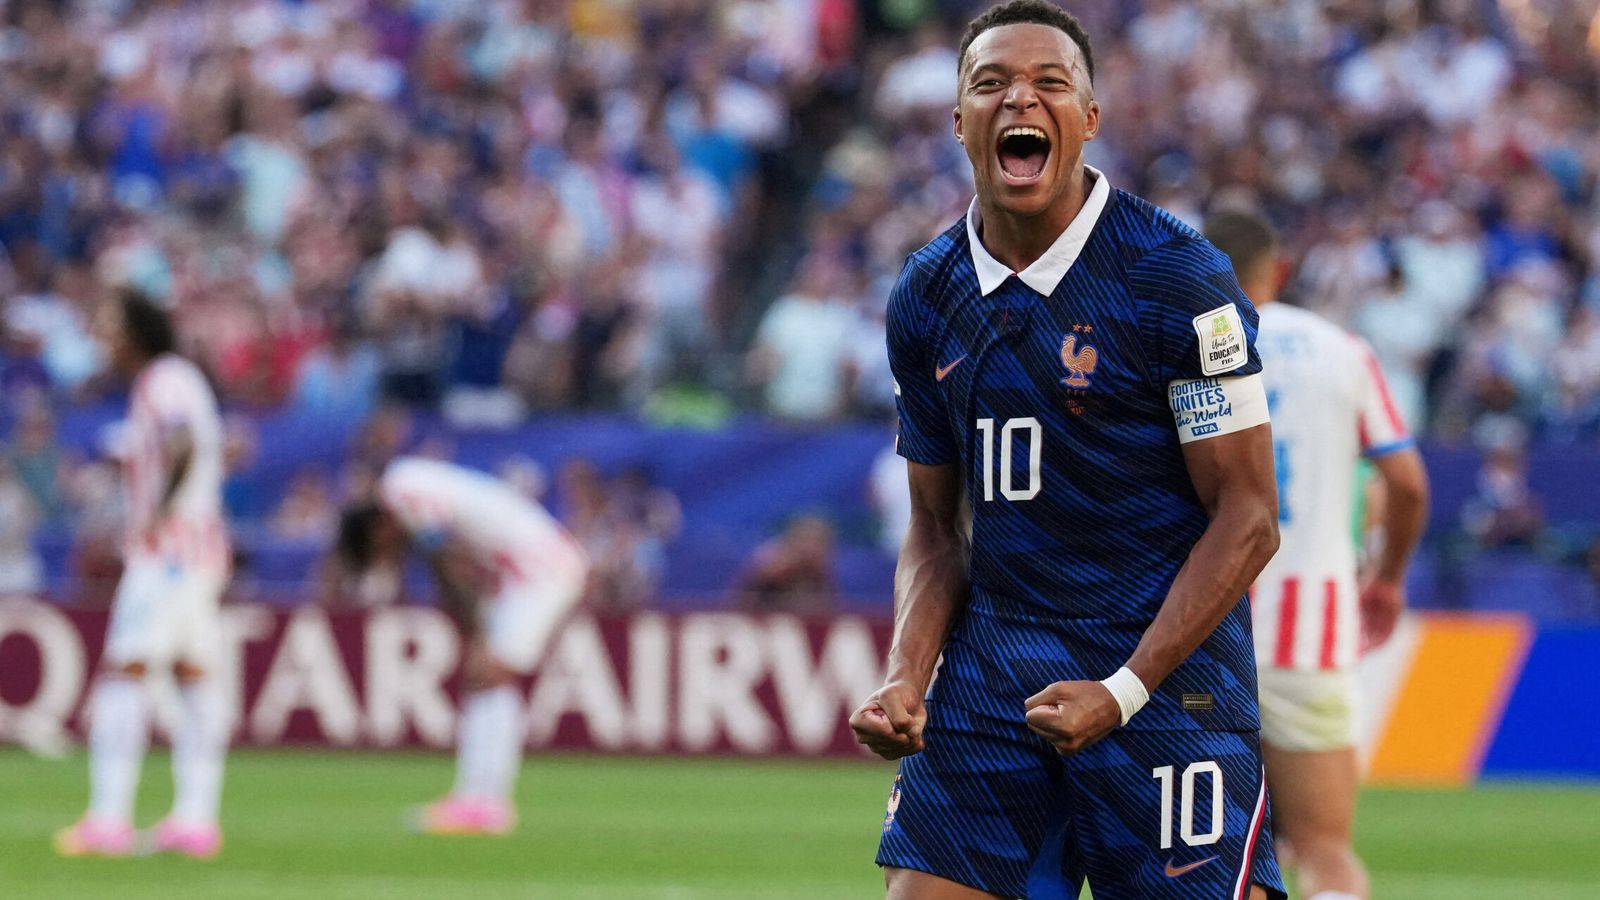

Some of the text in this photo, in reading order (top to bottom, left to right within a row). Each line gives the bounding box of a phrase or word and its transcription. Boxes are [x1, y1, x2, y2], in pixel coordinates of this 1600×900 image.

[1209, 343, 1240, 361] EDUCATION
[1171, 378, 1222, 397] FOOTBALL
[1171, 388, 1225, 413] UNITES
[1176, 402, 1232, 427] the World
[1193, 425, 1217, 435] FIFA
[976, 416, 1042, 502] 10
[1153, 760, 1224, 849] 10
